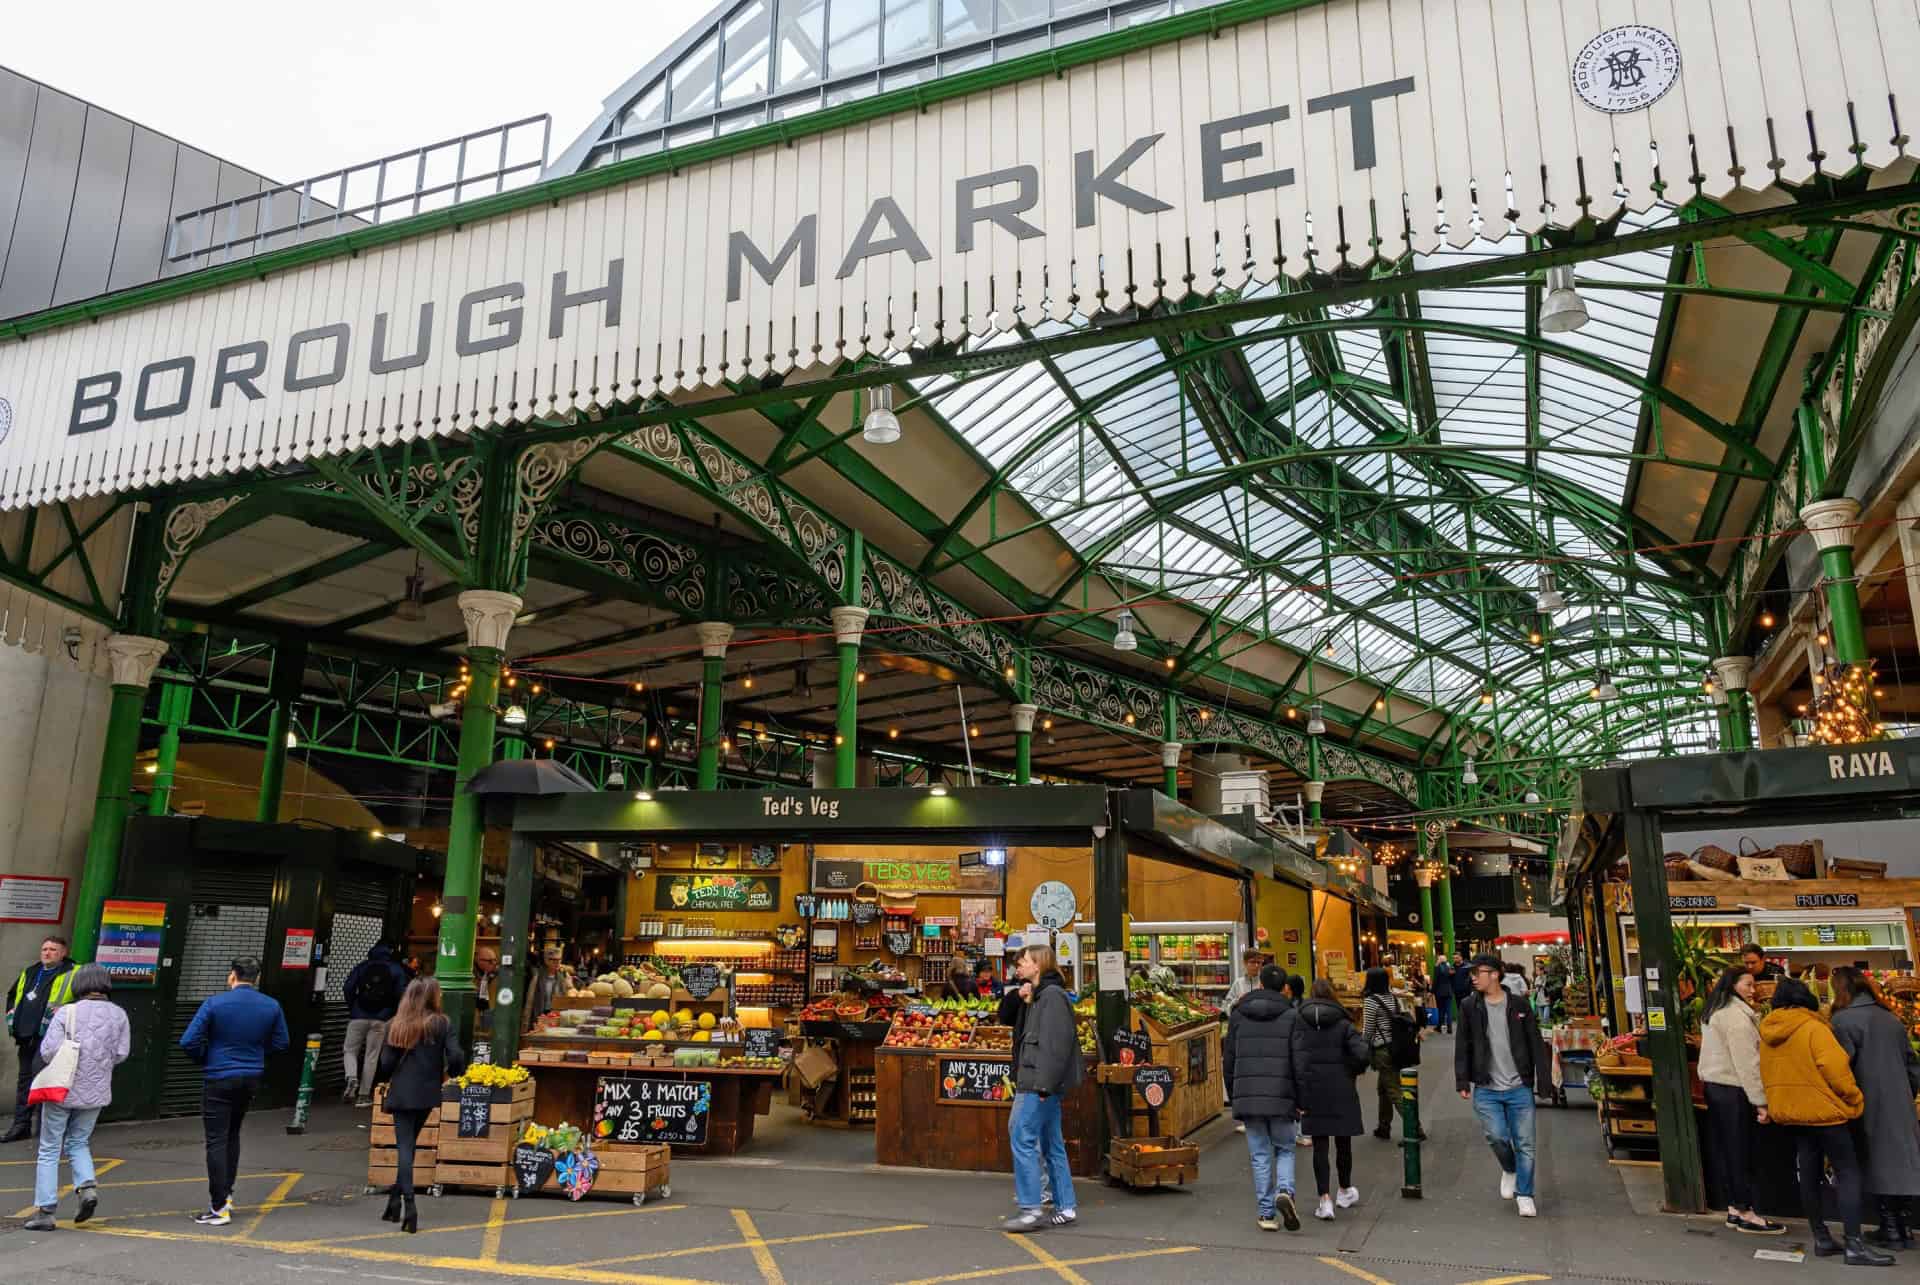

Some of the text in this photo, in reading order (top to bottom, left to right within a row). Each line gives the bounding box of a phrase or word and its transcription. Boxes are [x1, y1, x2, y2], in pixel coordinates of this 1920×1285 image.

[1578, 30, 1675, 90] BOROUGH MARKET
[67, 75, 1415, 437] BOROUGH MARKET
[1828, 751, 1896, 780] RAYA
[762, 795, 840, 819] Ted's Veg
[866, 862, 913, 881] TEDS
[914, 862, 951, 881] VEG
[1796, 895, 1826, 906] FRUIT
[1834, 894, 1857, 906] VEG
[104, 966, 152, 977] VERYONE
[948, 1061, 1010, 1078] ANY 3 FRUITS
[973, 1074, 991, 1088] £1
[604, 1082, 698, 1101] MIX & MATCH
[605, 1100, 687, 1120] ANY 3 FRUITS
[617, 1120, 641, 1140] £6
